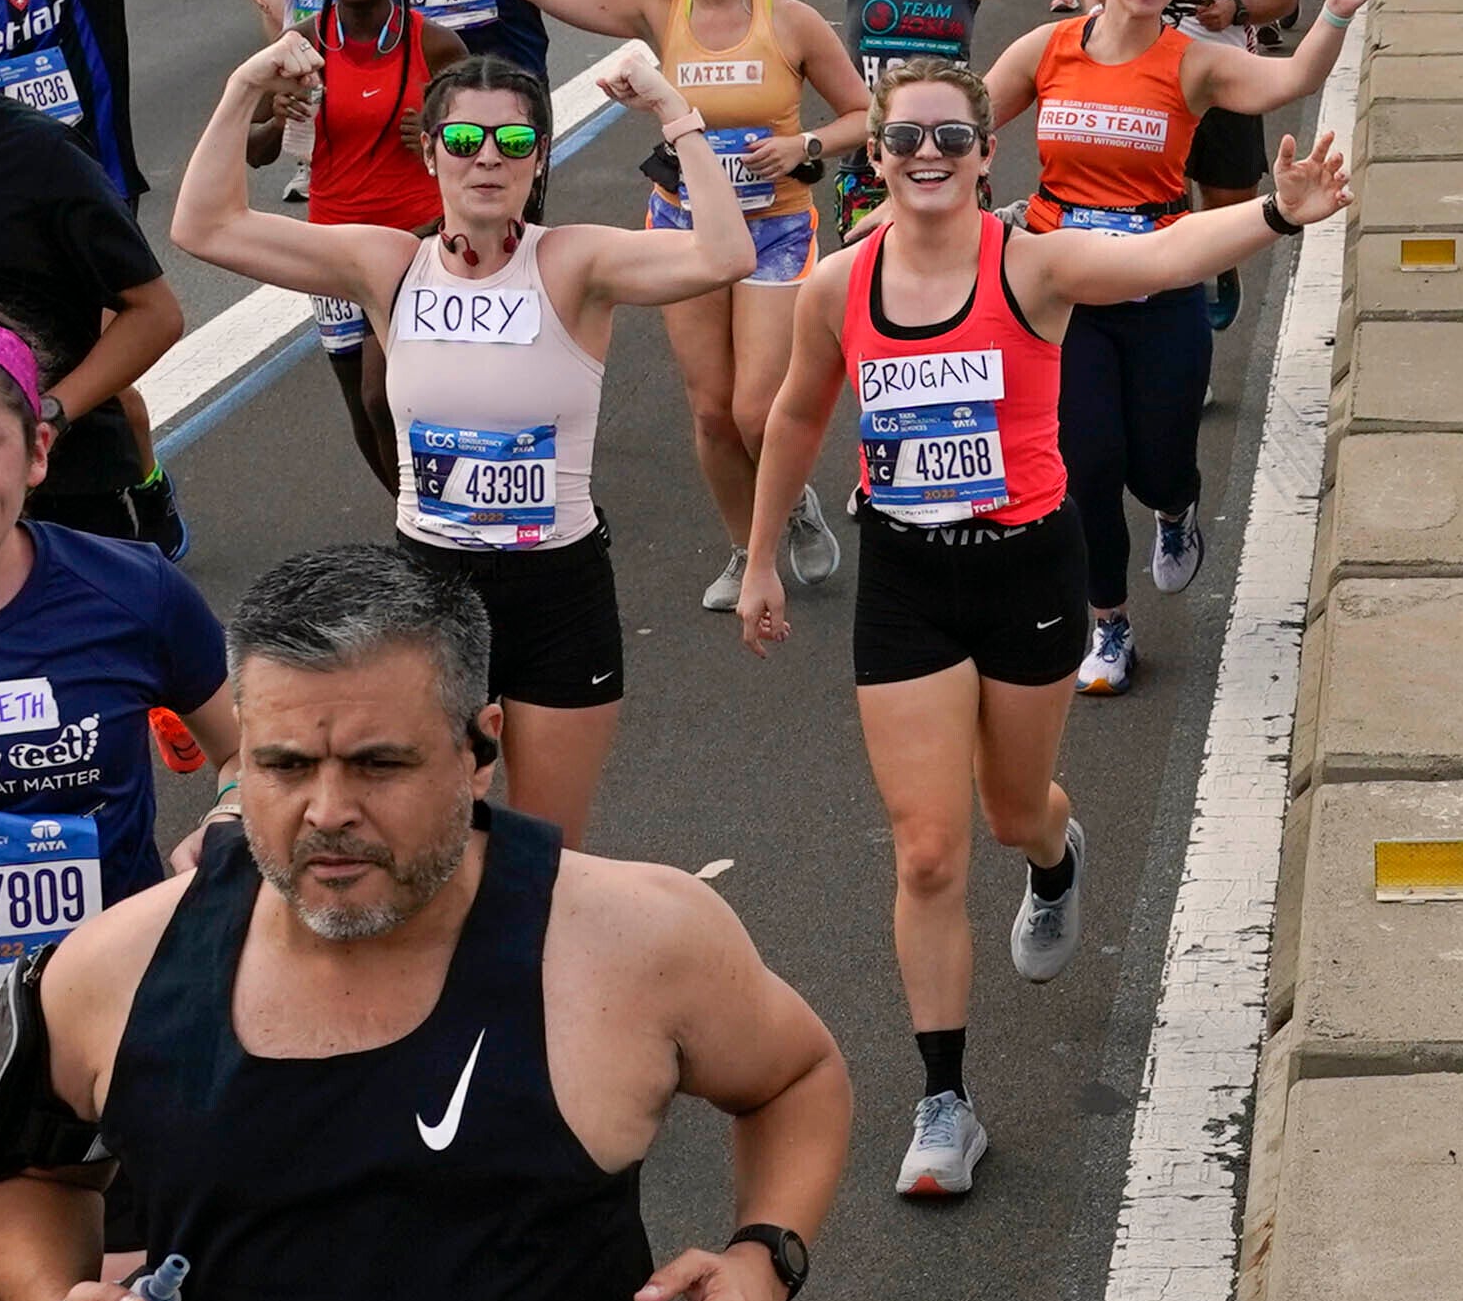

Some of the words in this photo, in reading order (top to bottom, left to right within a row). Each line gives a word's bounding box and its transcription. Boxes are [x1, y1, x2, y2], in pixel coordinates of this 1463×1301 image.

[901, 0, 954, 19] TEAM
[680, 65, 736, 85] KATIE
[1040, 110, 1098, 128] FRED'S
[1105, 115, 1162, 137] TEAM
[410, 289, 525, 334] RORY
[861, 355, 988, 403] BROGAN
[872, 411, 899, 432] tcs
[952, 419, 978, 428] TATA
[425, 430, 455, 449] tcs
[876, 446, 887, 458] 4
[916, 437, 993, 481] 43268
[426, 460, 438, 473] 4
[466, 464, 545, 504] 43390
[972, 503, 994, 514] TCS
[518, 528, 540, 539] TCS
[11, 724, 82, 770] feet
[23, 767, 102, 794] MATTER
[27, 839, 68, 854] TATA
